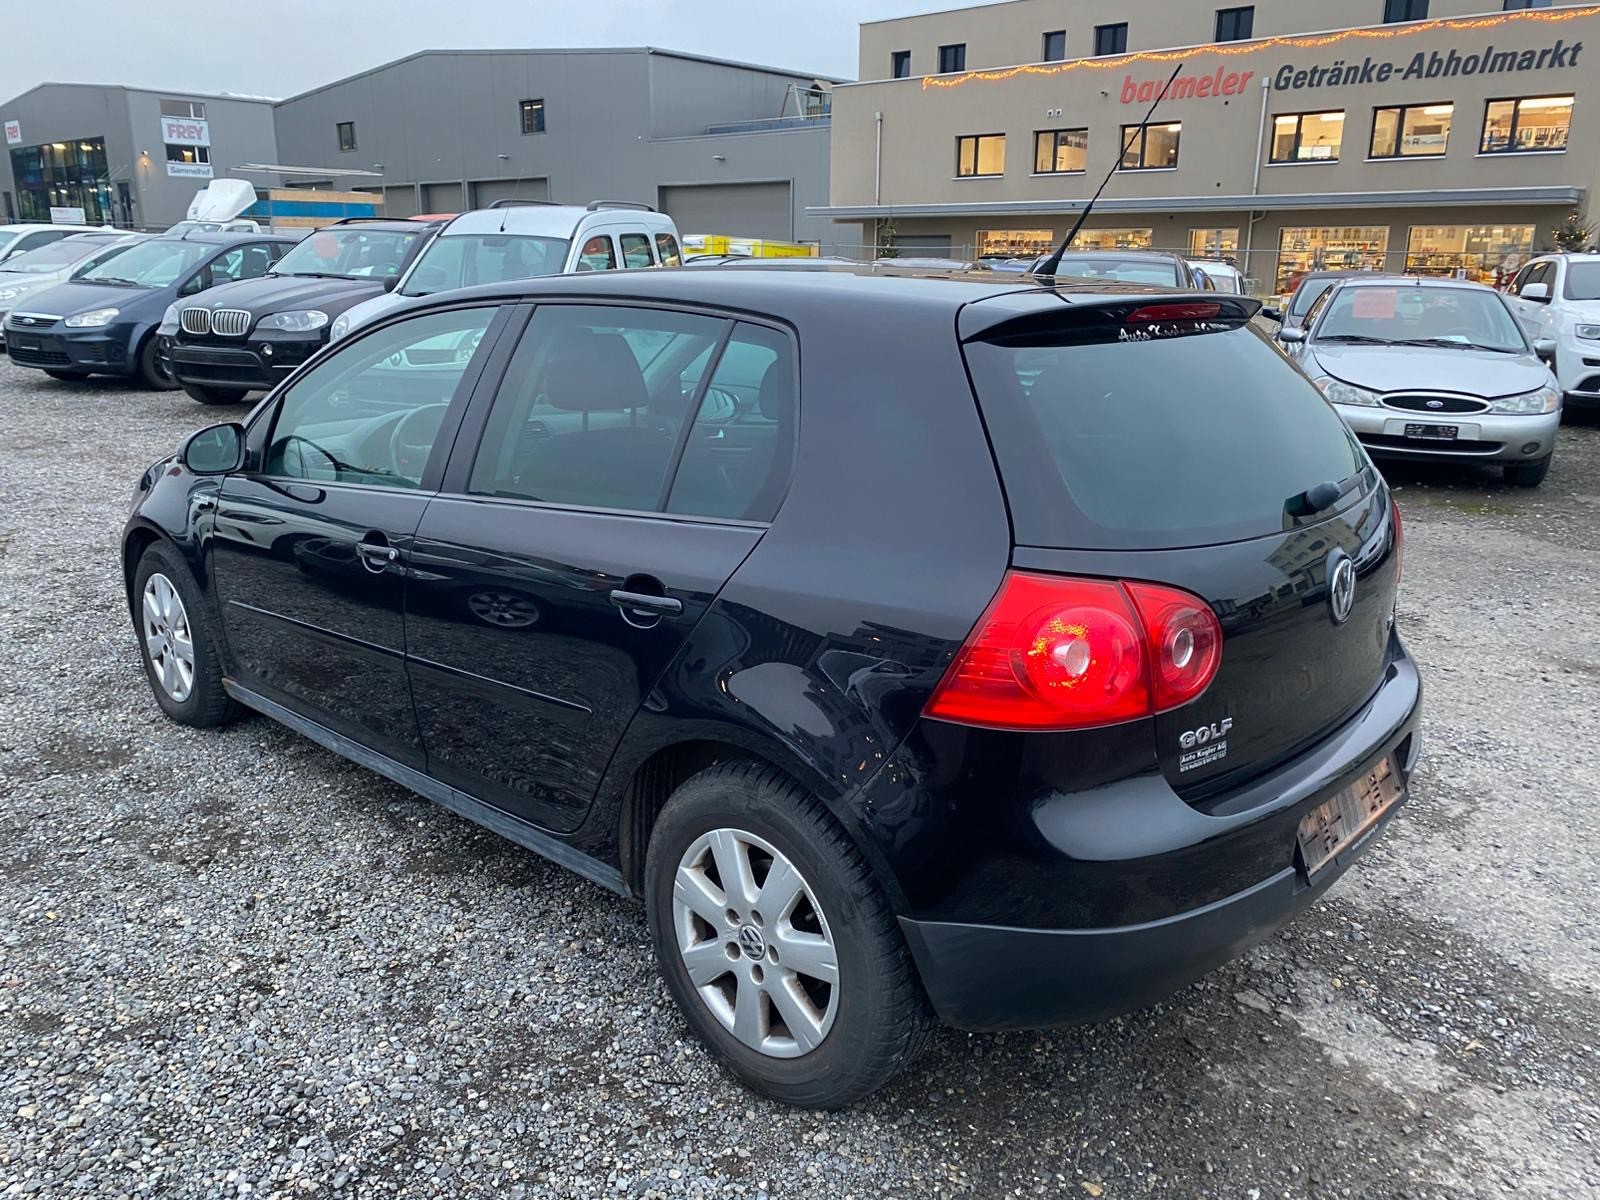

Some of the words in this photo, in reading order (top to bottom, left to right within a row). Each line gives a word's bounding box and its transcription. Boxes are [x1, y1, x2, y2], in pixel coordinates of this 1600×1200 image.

[1274, 39, 1583, 92] Getränke-Abholmarkt
[1119, 65, 1255, 104] baumeler
[166, 123, 204, 141] FREY
[170, 166, 210, 176] Sammelhof
[1179, 716, 1233, 749] GOLF
